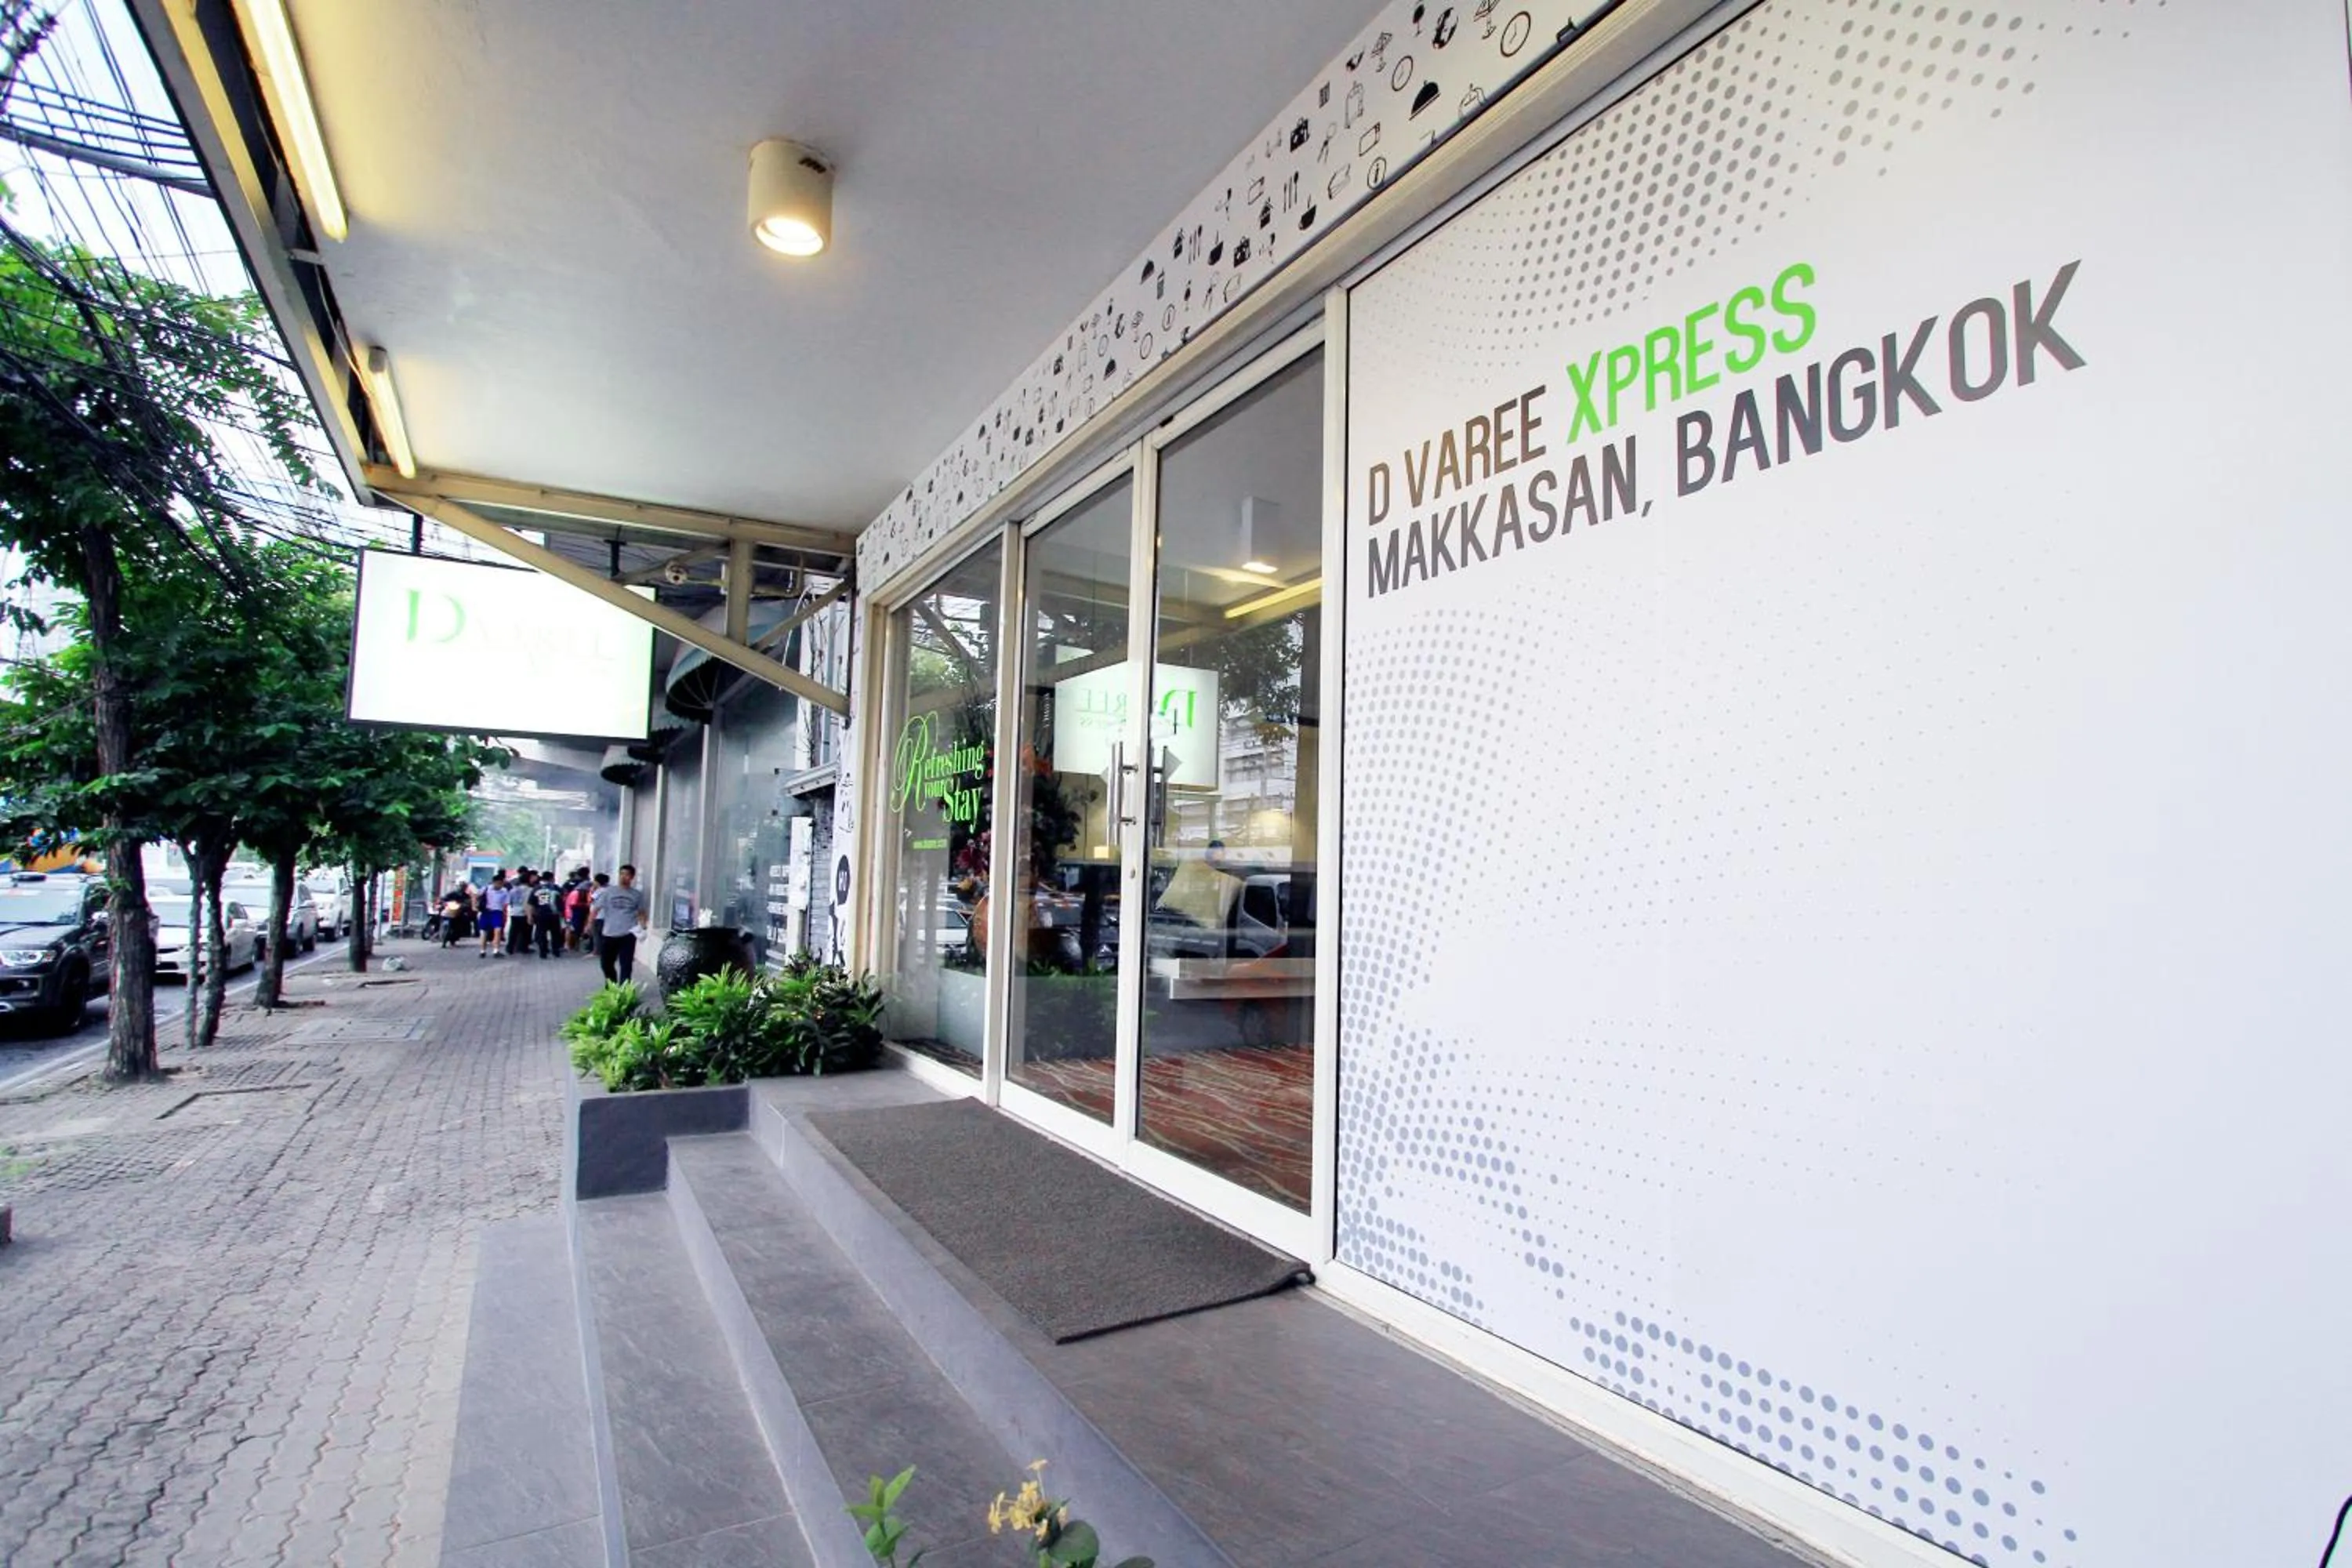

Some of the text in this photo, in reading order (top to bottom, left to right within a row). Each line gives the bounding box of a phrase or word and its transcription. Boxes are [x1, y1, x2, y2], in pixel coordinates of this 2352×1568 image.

[1368, 262, 1817, 526] D VAREE XPRESS
[1368, 260, 2088, 598] MAKKASAN, BANGKOK
[890, 710, 985, 813] Refreshing
[942, 777, 984, 834] Stay
